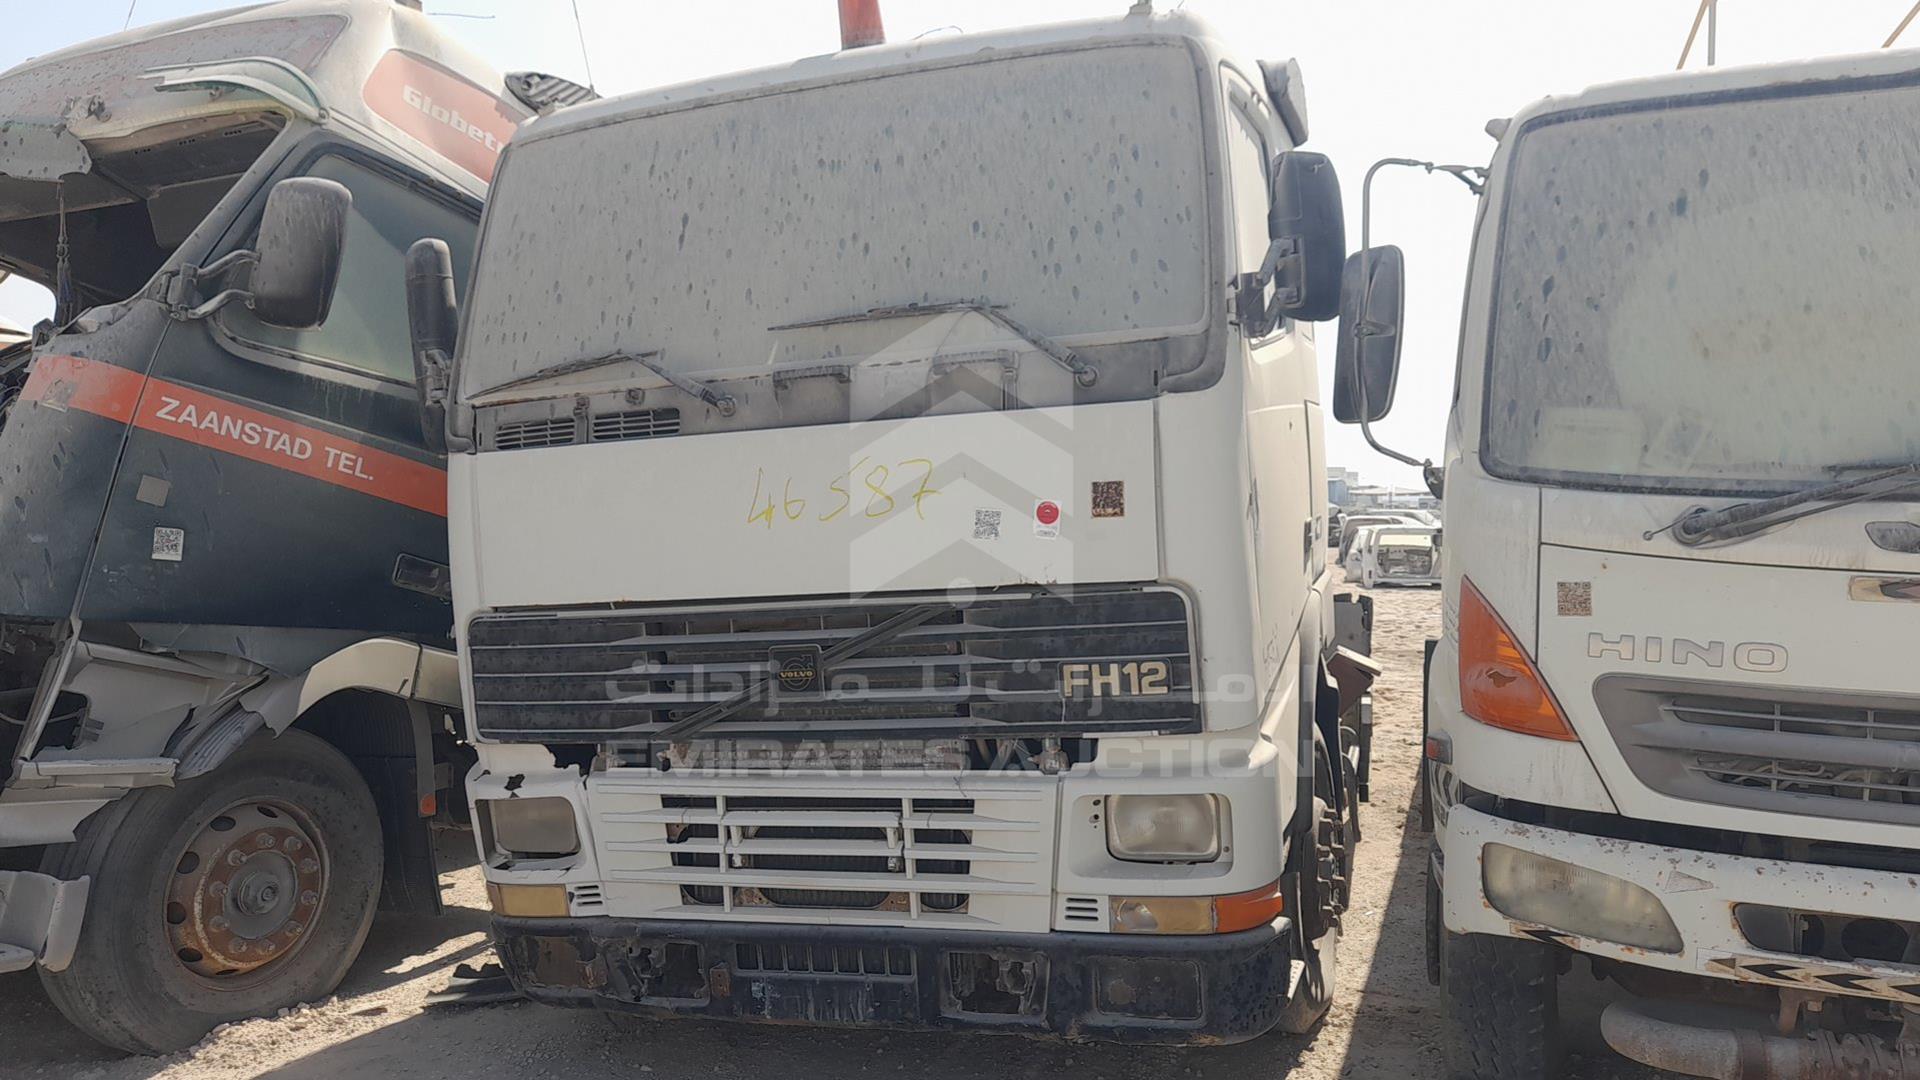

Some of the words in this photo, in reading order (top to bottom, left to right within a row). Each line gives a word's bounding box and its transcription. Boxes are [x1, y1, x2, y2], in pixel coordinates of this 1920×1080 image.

[155, 396, 312, 460] ZAANSTAD
[324, 446, 374, 481] TEL.
[1587, 632, 1788, 673] HINO
[780, 670, 814, 678] VOLVO
[1063, 661, 1168, 696] FH12
